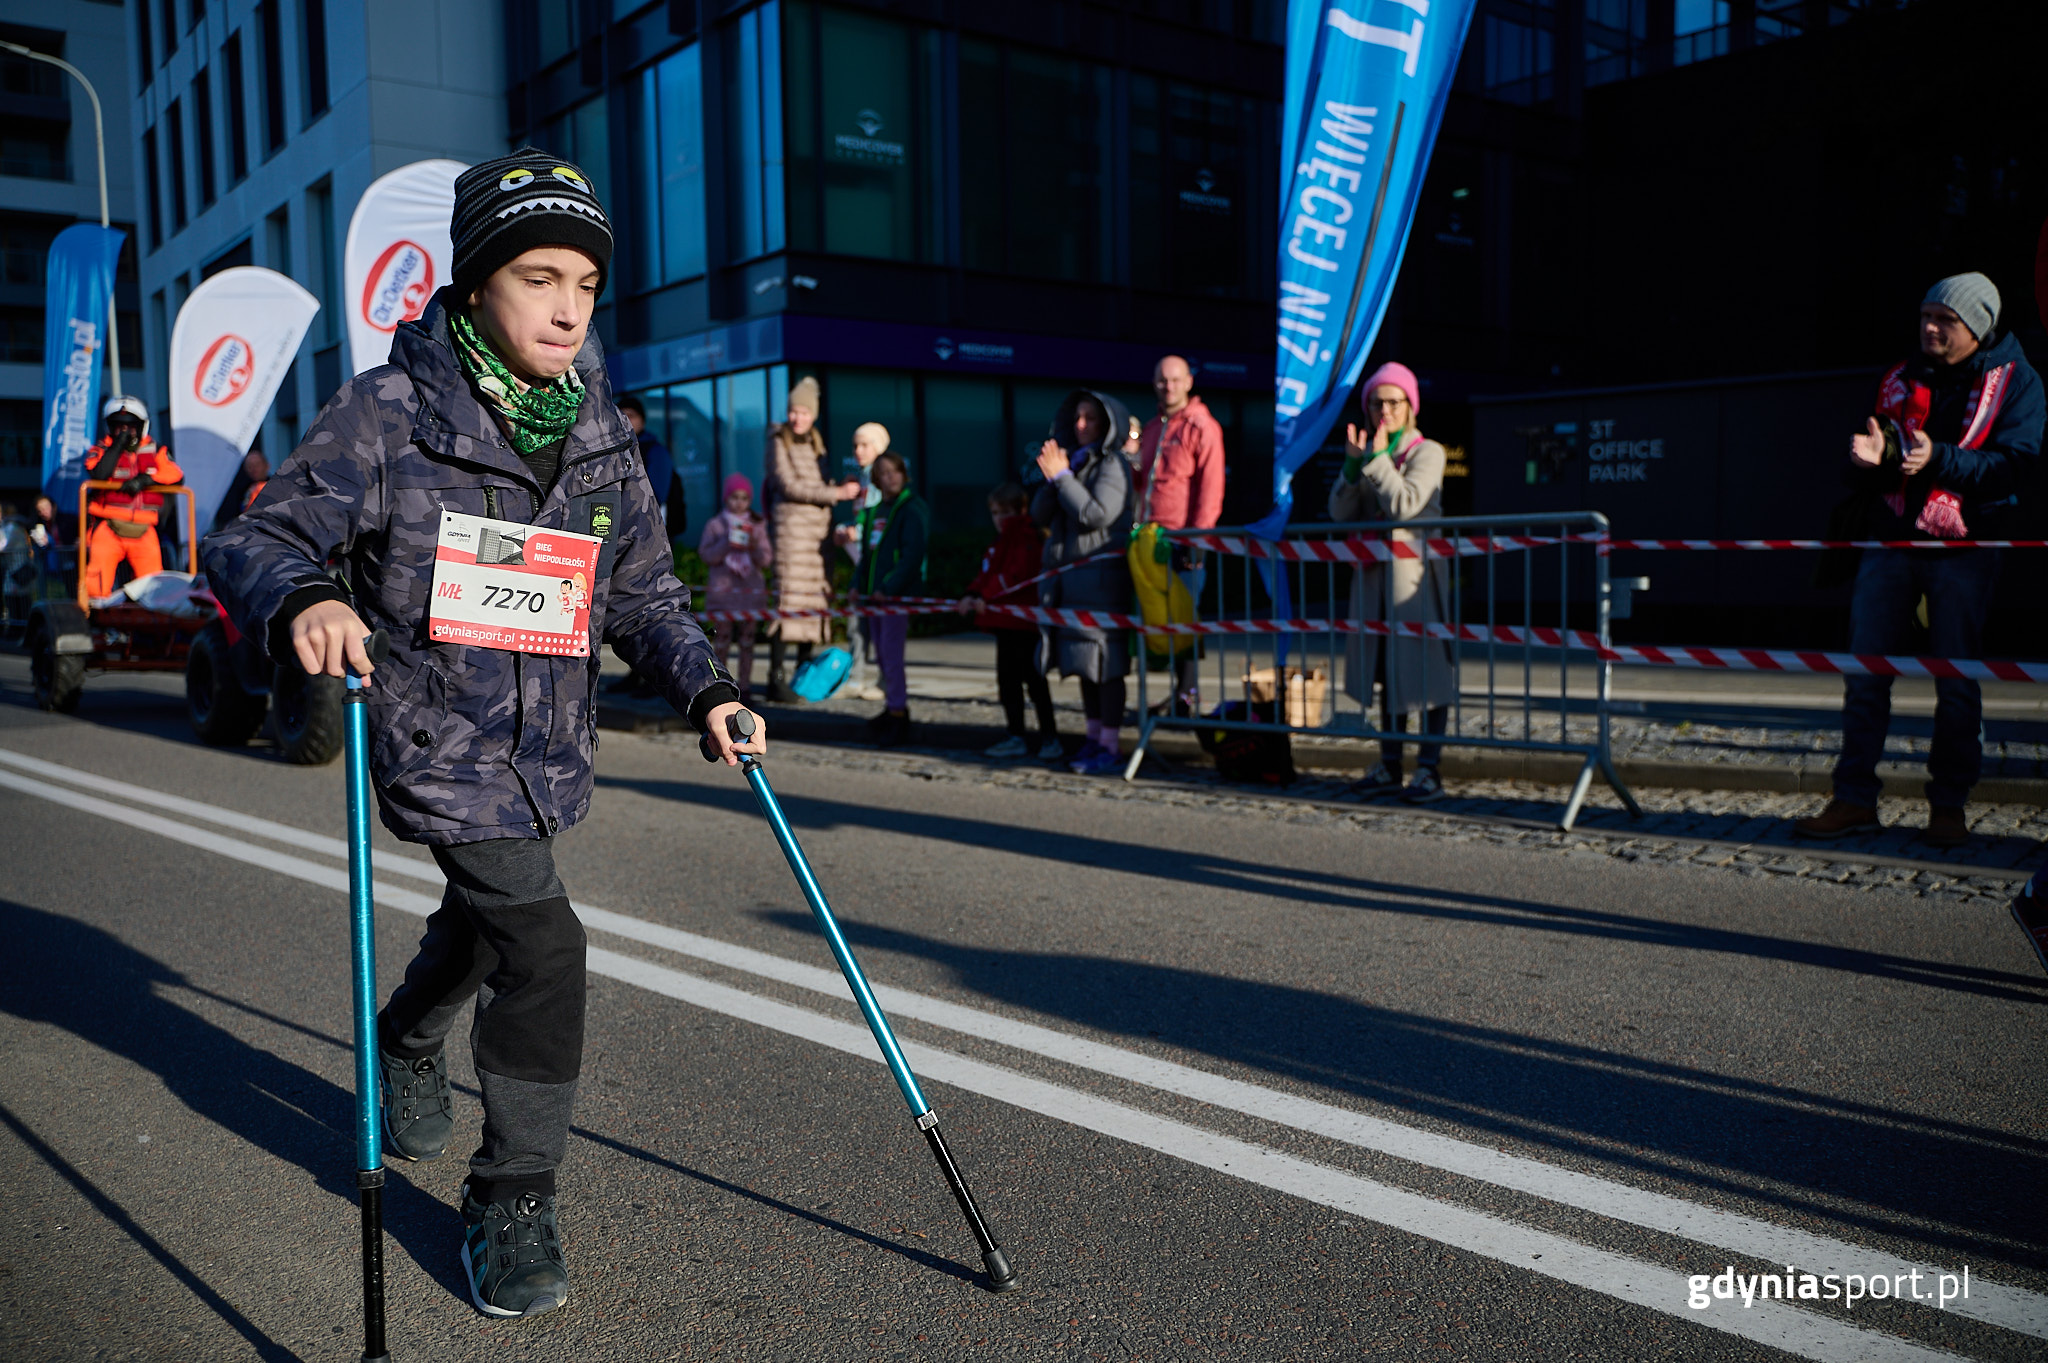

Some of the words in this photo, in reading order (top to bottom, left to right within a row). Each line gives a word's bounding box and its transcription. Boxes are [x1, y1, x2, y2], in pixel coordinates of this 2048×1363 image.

[1287, 100, 1378, 273] WIĘCEJ
[382, 248, 419, 304] Oetker
[1277, 280, 1332, 367] NIŻ
[1588, 419, 1617, 440] 3T
[1588, 438, 1665, 461] OFFICE
[1588, 462, 1649, 484] PARK
[535, 543, 552, 553] BIEG
[534, 552, 586, 569] NIEPODLEGŁOŚCI
[437, 581, 463, 600] MŁ
[481, 585, 545, 613] 7270
[435, 624, 515, 643] gdyniasport.pl
